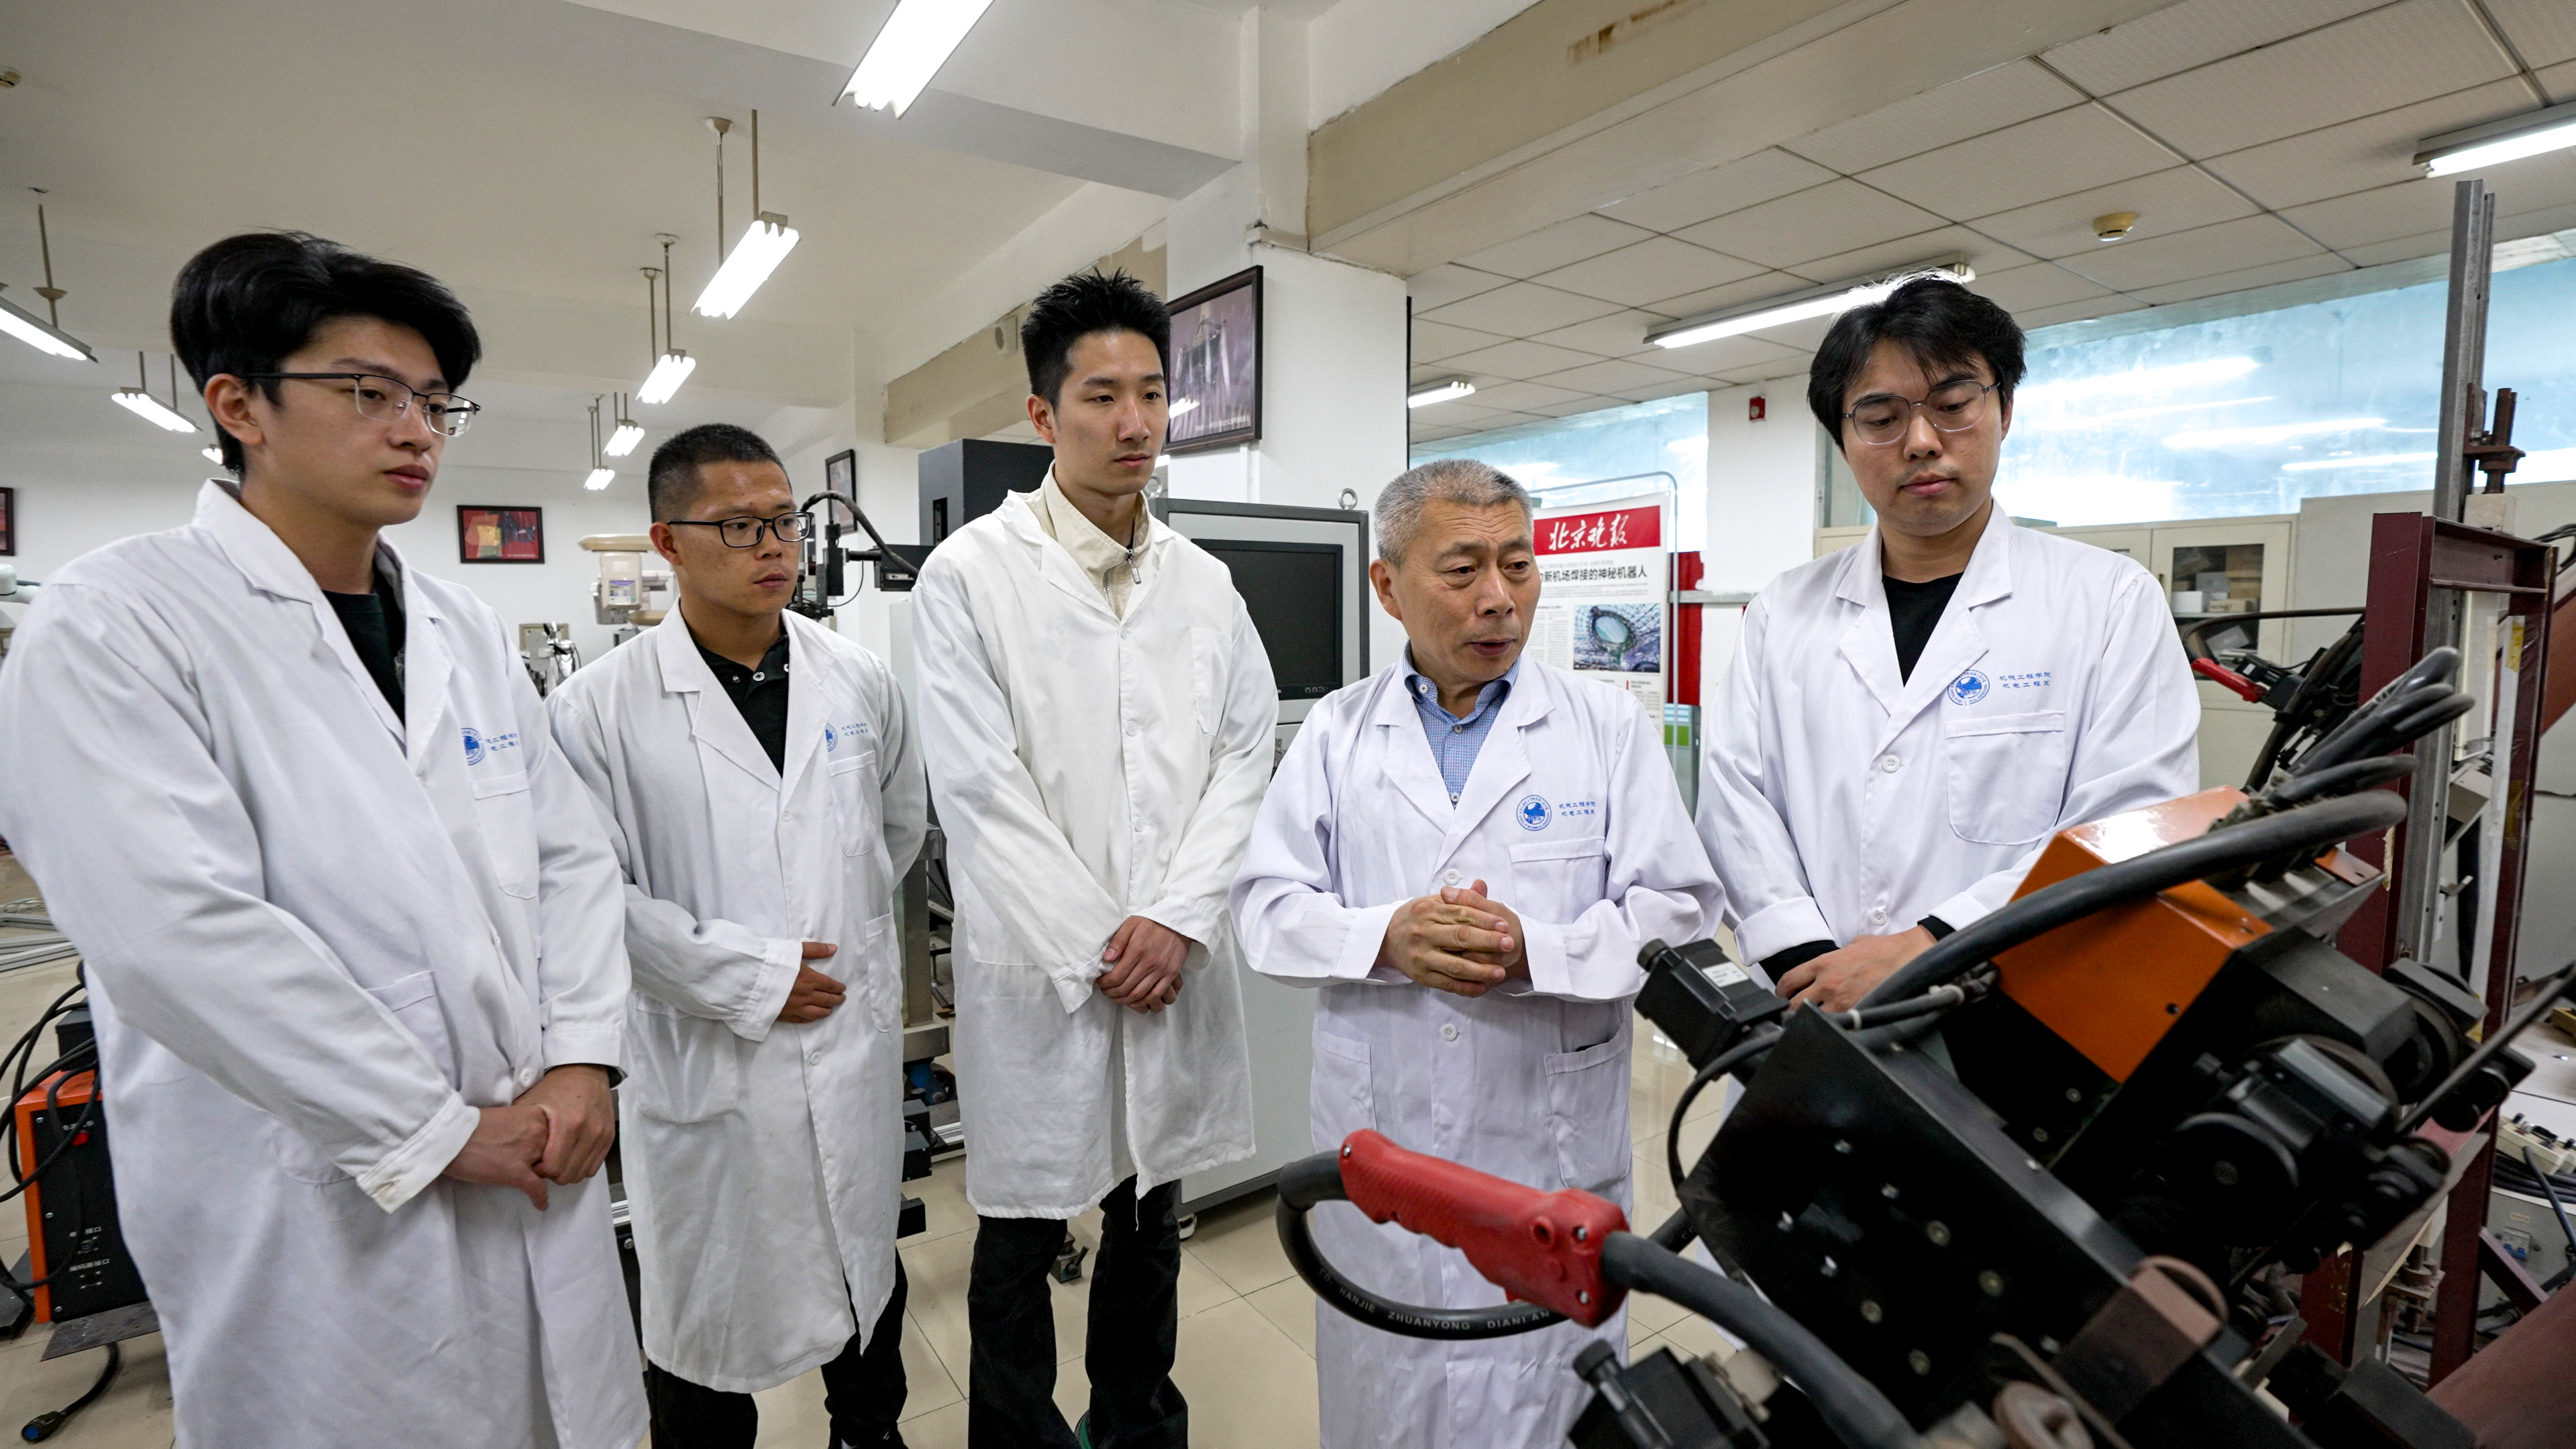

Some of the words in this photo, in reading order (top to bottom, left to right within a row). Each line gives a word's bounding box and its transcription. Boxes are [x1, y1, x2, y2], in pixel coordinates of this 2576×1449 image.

[1548, 513, 1629, 551] 北京晚报
[1387, 1311, 1470, 1330] ZHUANYONG
